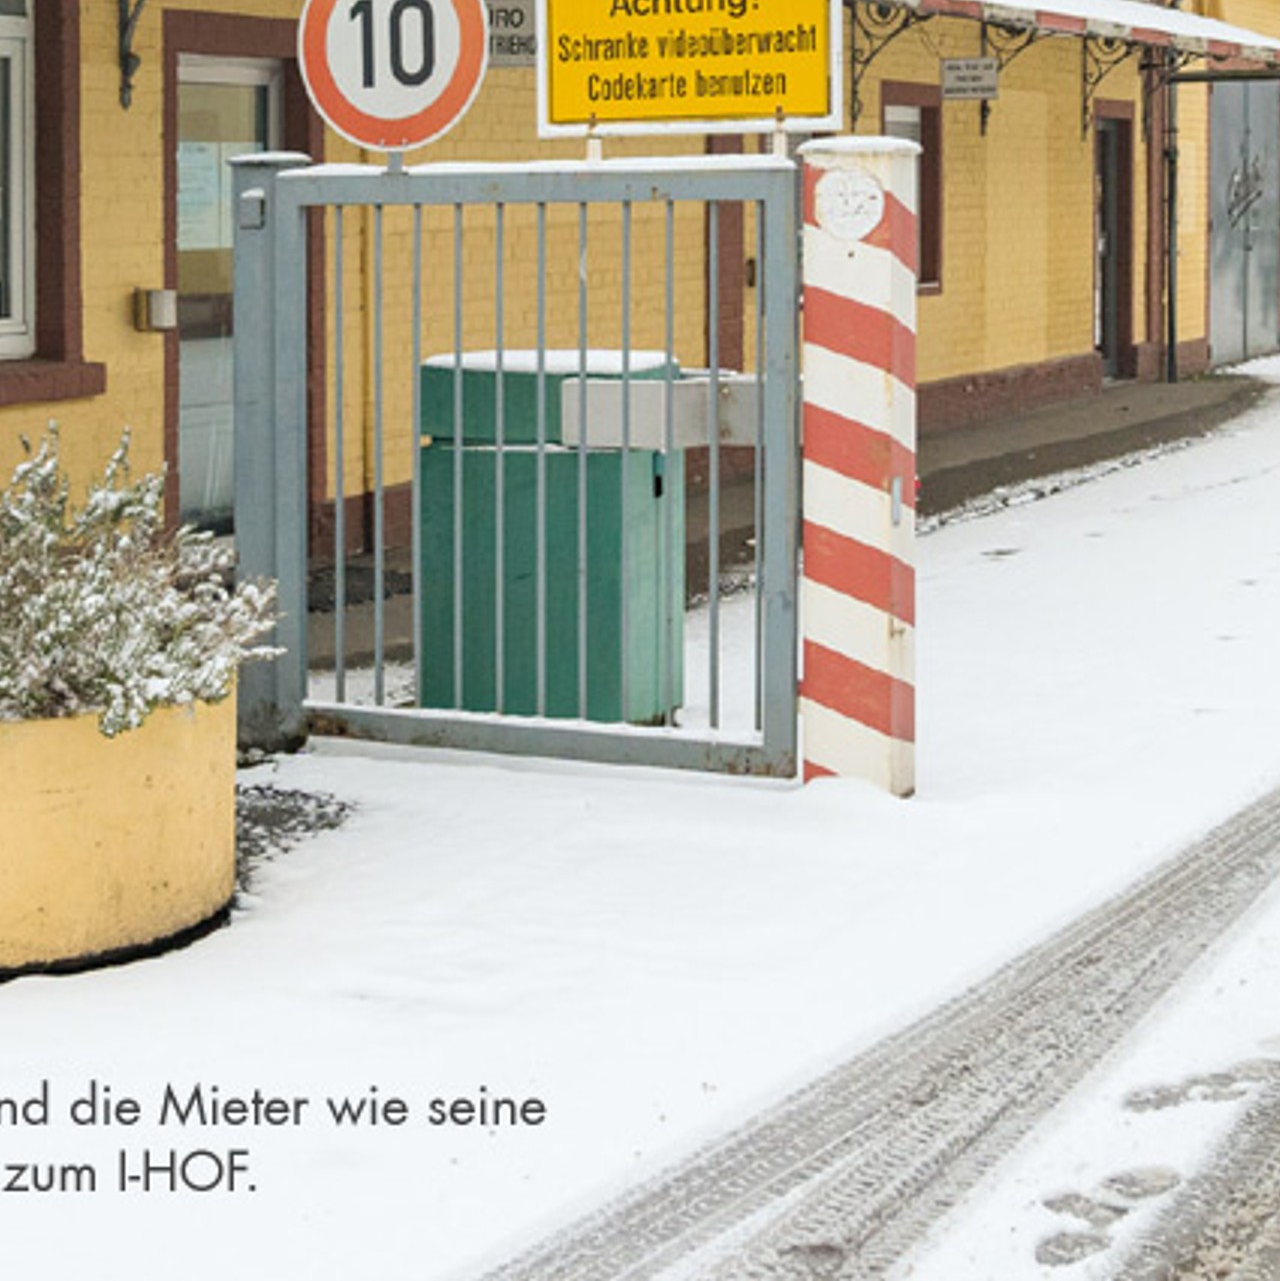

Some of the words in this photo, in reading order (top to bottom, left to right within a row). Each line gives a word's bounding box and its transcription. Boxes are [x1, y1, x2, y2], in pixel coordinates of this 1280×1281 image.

[557, 32, 650, 63] Schranke
[656, 23, 818, 59] videoüberwacht
[587, 71, 687, 102] Codekarte
[695, 69, 788, 98] benutzen
